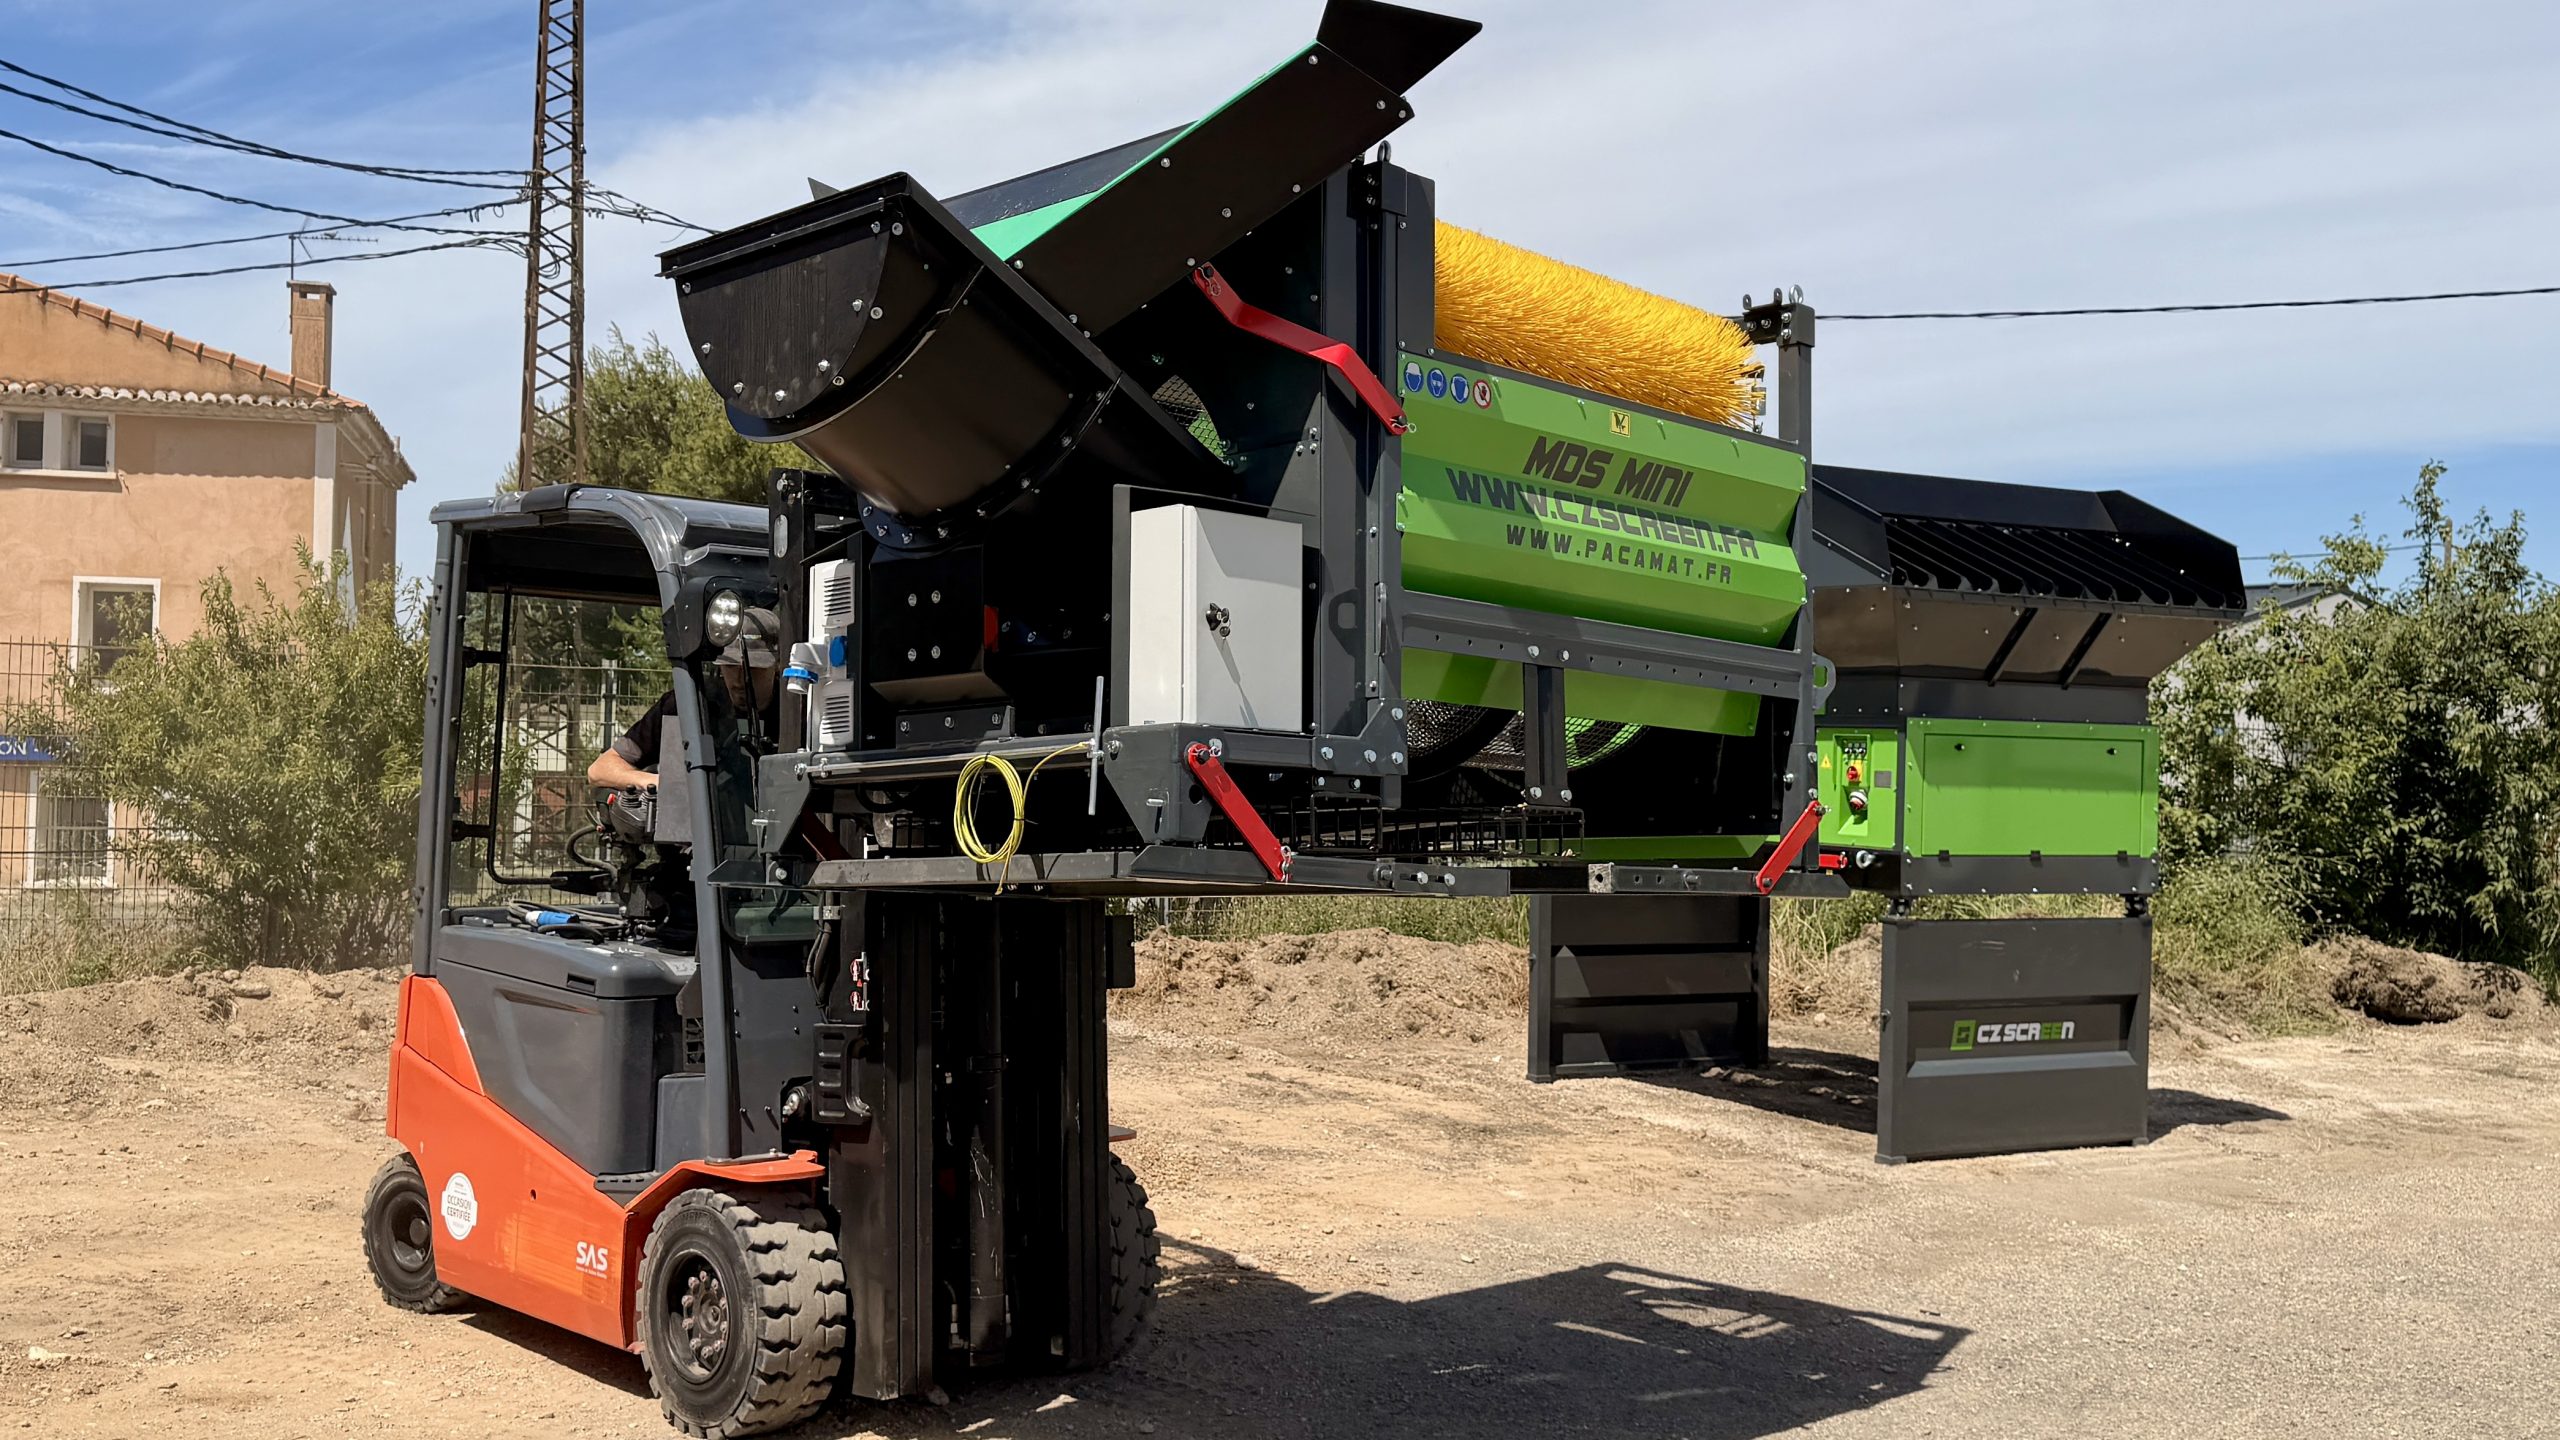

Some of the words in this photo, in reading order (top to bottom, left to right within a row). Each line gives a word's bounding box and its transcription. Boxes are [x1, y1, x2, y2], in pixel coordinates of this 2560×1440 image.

[1522, 435, 1614, 489] MDS
[1614, 457, 1694, 508] MINI
[1445, 467, 1760, 560] WWW.CZSCREEN.FR
[1506, 524, 1732, 585] WWW.PACAMAT.FR
[1976, 1020, 2076, 1044] CZSCREEN
[446, 1194, 473, 1211] OCCASION
[575, 1240, 609, 1272] SAS
